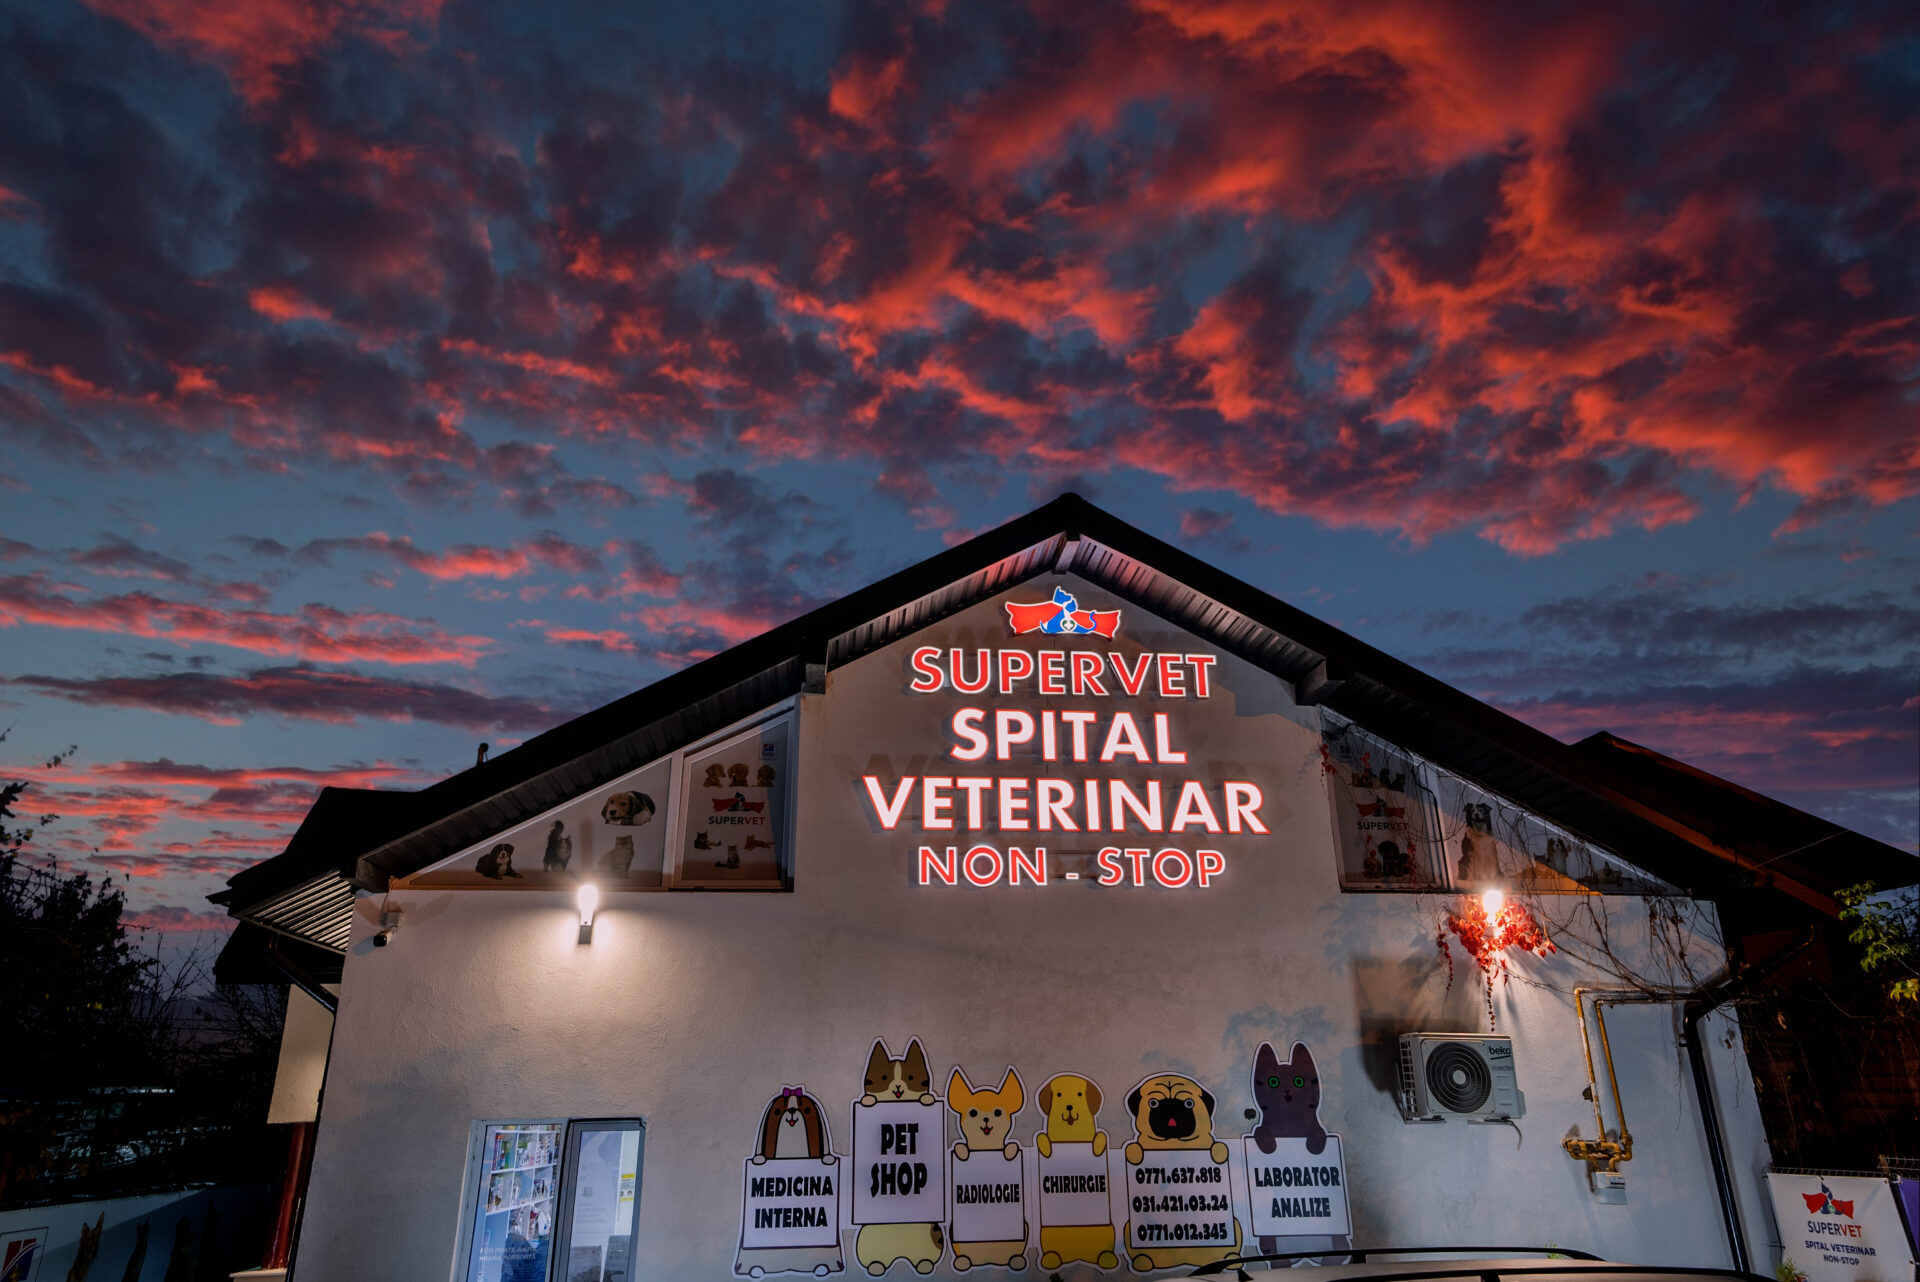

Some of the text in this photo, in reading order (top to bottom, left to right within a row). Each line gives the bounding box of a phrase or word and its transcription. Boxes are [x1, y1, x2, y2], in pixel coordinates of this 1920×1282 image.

[910, 646, 1216, 698] SUPERVET
[951, 707, 1187, 764] SPITAL
[862, 775, 1270, 835] VETERINAR
[708, 815, 766, 825] SUPERVET
[1357, 821, 1409, 831] SUPERVET
[918, 845, 1048, 887] NON
[1097, 846, 1226, 889] STOP
[1489, 1046, 1511, 1055] beko
[880, 1123, 919, 1155] PET
[870, 1162, 928, 1198] SHOP
[1042, 1175, 1107, 1194] CHIRURGIE
[1135, 1167, 1222, 1185] 0771.637.818
[1254, 1166, 1341, 1188] LABORATOR
[751, 1176, 834, 1198] MEDICINA
[956, 1183, 1020, 1204] RADIOLOGIE
[1132, 1195, 1228, 1213] 031.421.03.24
[1271, 1197, 1332, 1219] ANALIZE
[754, 1206, 828, 1229] INTERNA
[1137, 1223, 1228, 1242] 0771.012.345
[1807, 1220, 1862, 1238] SUPERVET
[1805, 1240, 1876, 1257] SPITAL VETERINAR
[1823, 1254, 1860, 1266] NON-STOP
